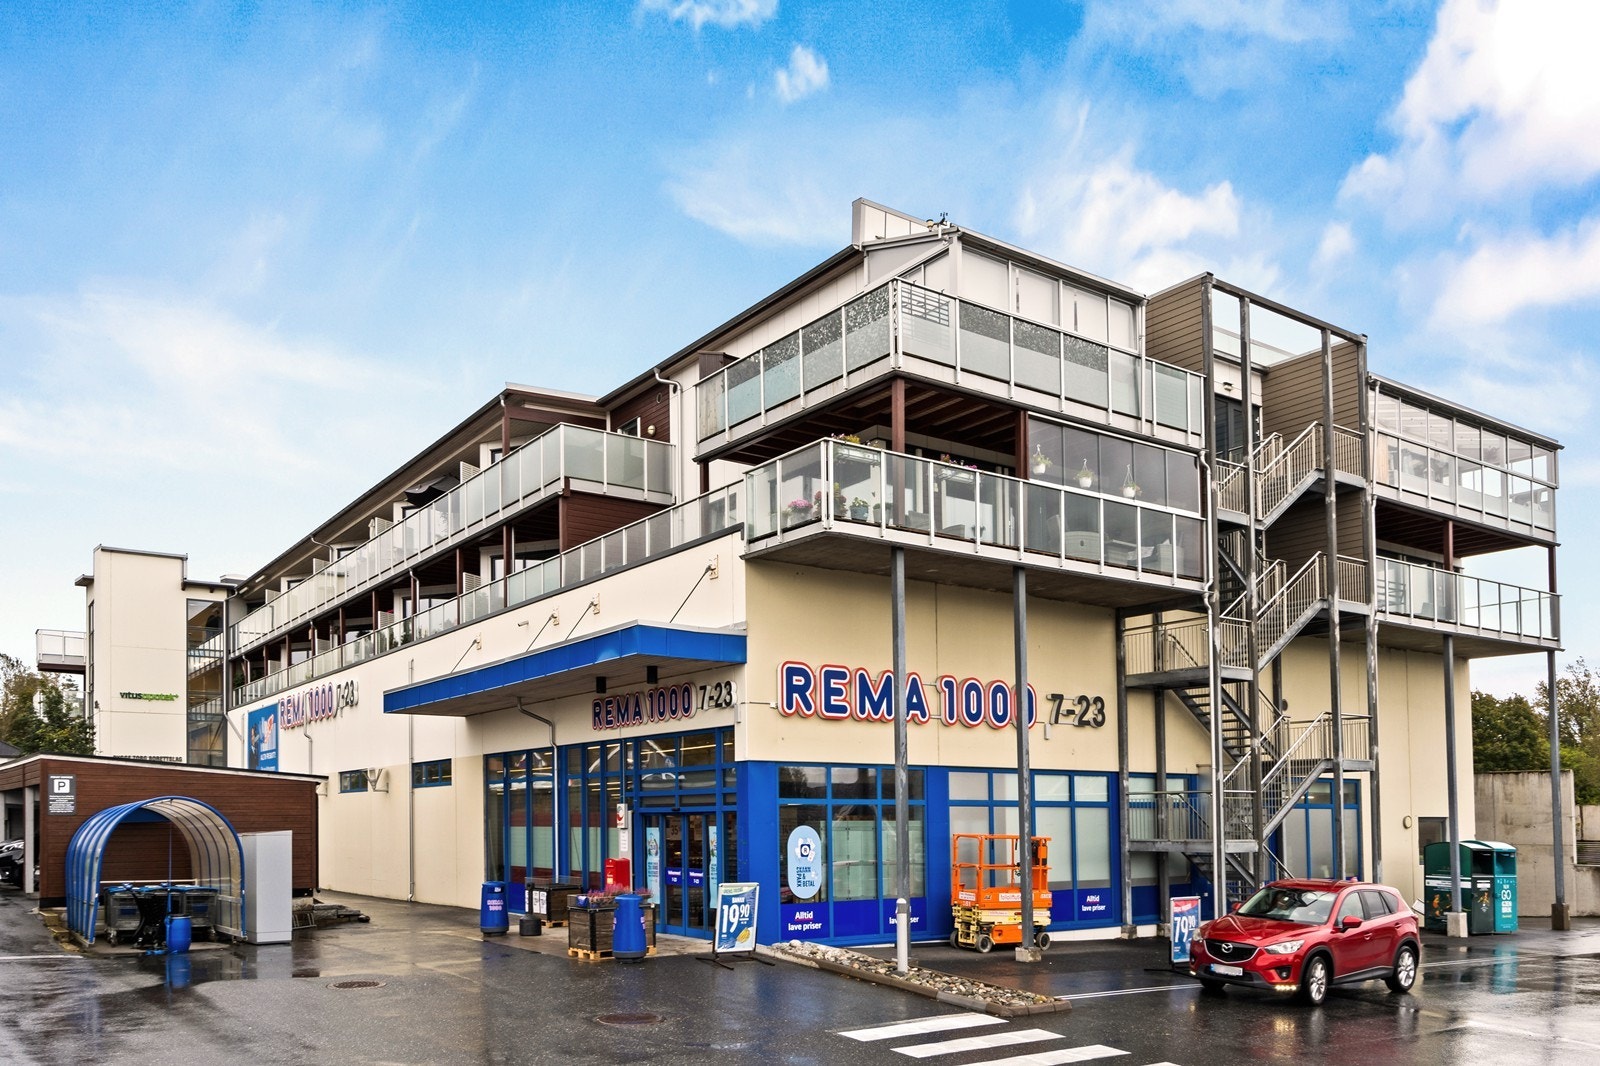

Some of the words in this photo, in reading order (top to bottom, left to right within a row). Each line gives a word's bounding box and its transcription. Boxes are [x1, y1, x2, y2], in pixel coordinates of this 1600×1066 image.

[308, 682, 334, 721] 1000
[335, 680, 356, 716] 7-23
[592, 692, 645, 730] REMA
[648, 682, 694, 723] 1000
[699, 681, 734, 710] 7-23
[779, 660, 930, 724] REMA
[1048, 693, 1105, 727] 7-23
[58, 781, 66, 791] P
[721, 904, 739, 933] 19
[739, 904, 750, 917] 90
[788, 923, 802, 931] lave
[802, 921, 822, 932] priser
[794, 911, 813, 920] Alltid
[1173, 916, 1189, 943] 79
